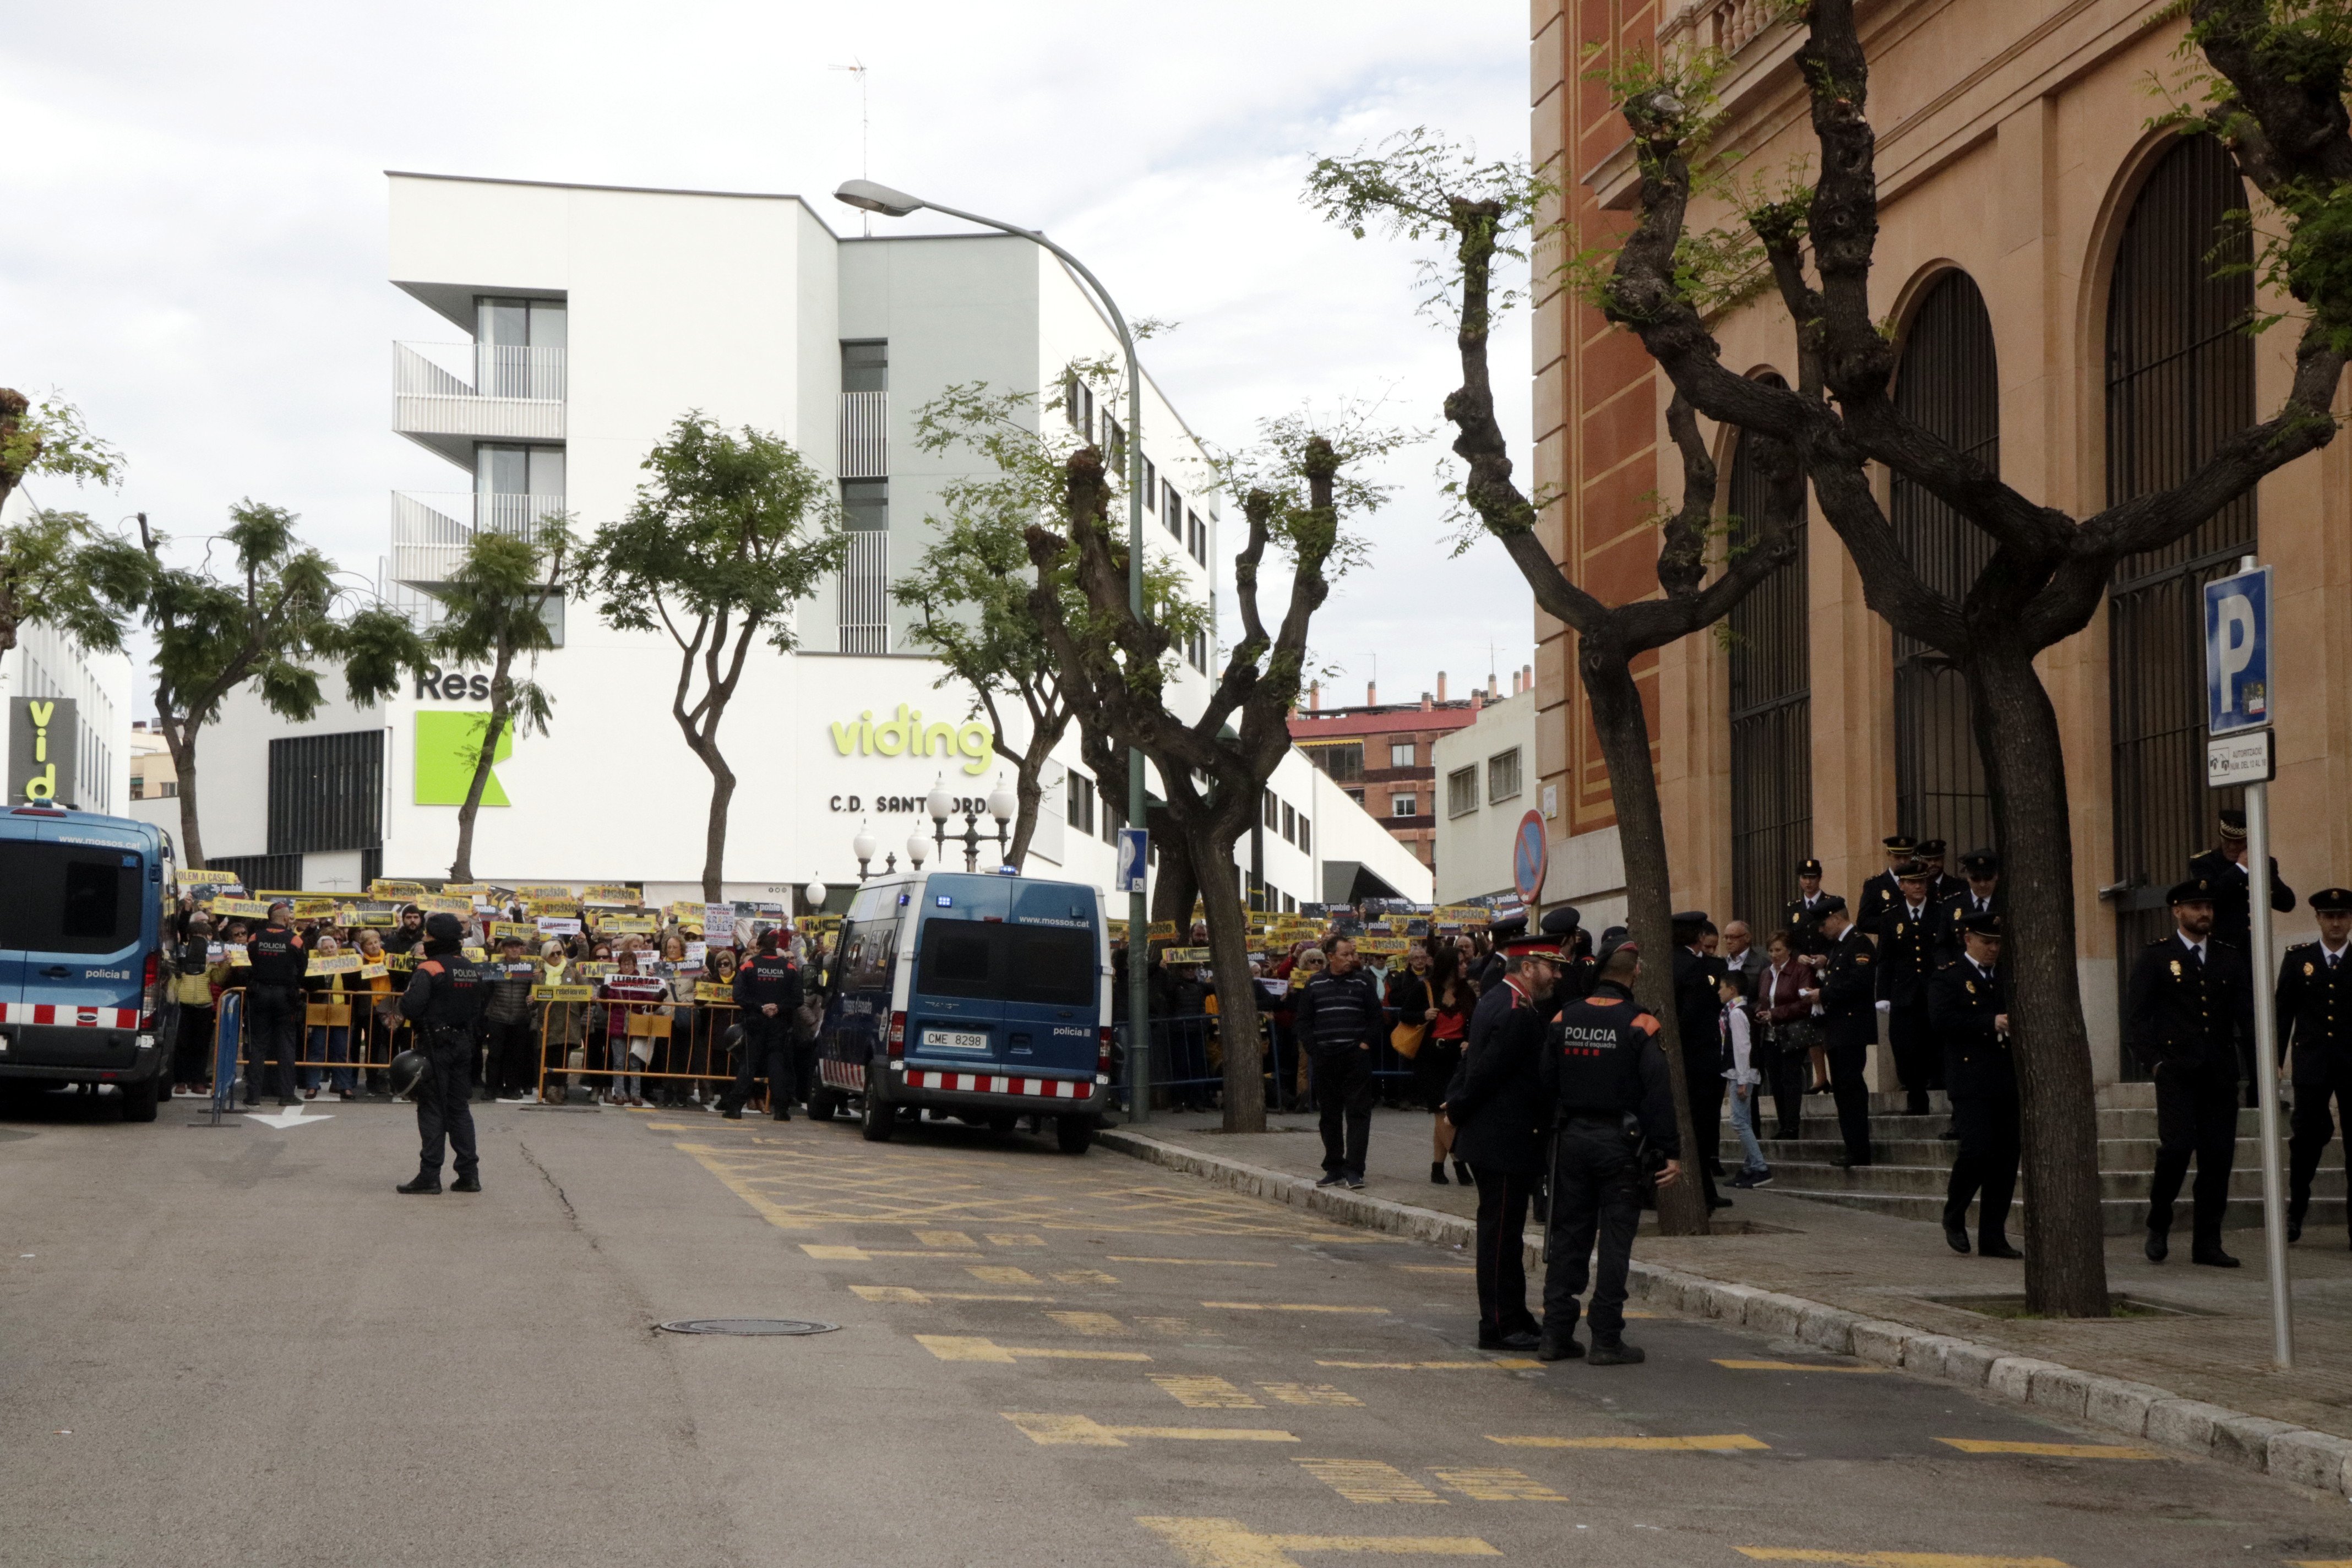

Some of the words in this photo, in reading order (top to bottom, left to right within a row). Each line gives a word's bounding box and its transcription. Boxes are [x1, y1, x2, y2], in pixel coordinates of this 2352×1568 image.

[2218, 594, 2255, 714] P
[416, 664, 514, 700] Res
[831, 703, 993, 774] viding
[876, 796, 927, 813] SANT
[59, 835, 140, 850] www.mossos.cat
[1119, 836, 1136, 884] P
[200, 872, 206, 881] A
[208, 873, 230, 883] CASA!
[221, 884, 243, 893] poble
[1019, 916, 1090, 928] www.mossos.cat
[509, 962, 532, 972] poble
[677, 960, 700, 971] poble
[86, 969, 120, 979] policia
[453, 968, 477, 978] POLICIA
[1053, 1026, 1083, 1037] policia
[1565, 1026, 1616, 1042] POLICIA
[928, 1033, 948, 1044] CME
[955, 1035, 982, 1047] 8298
